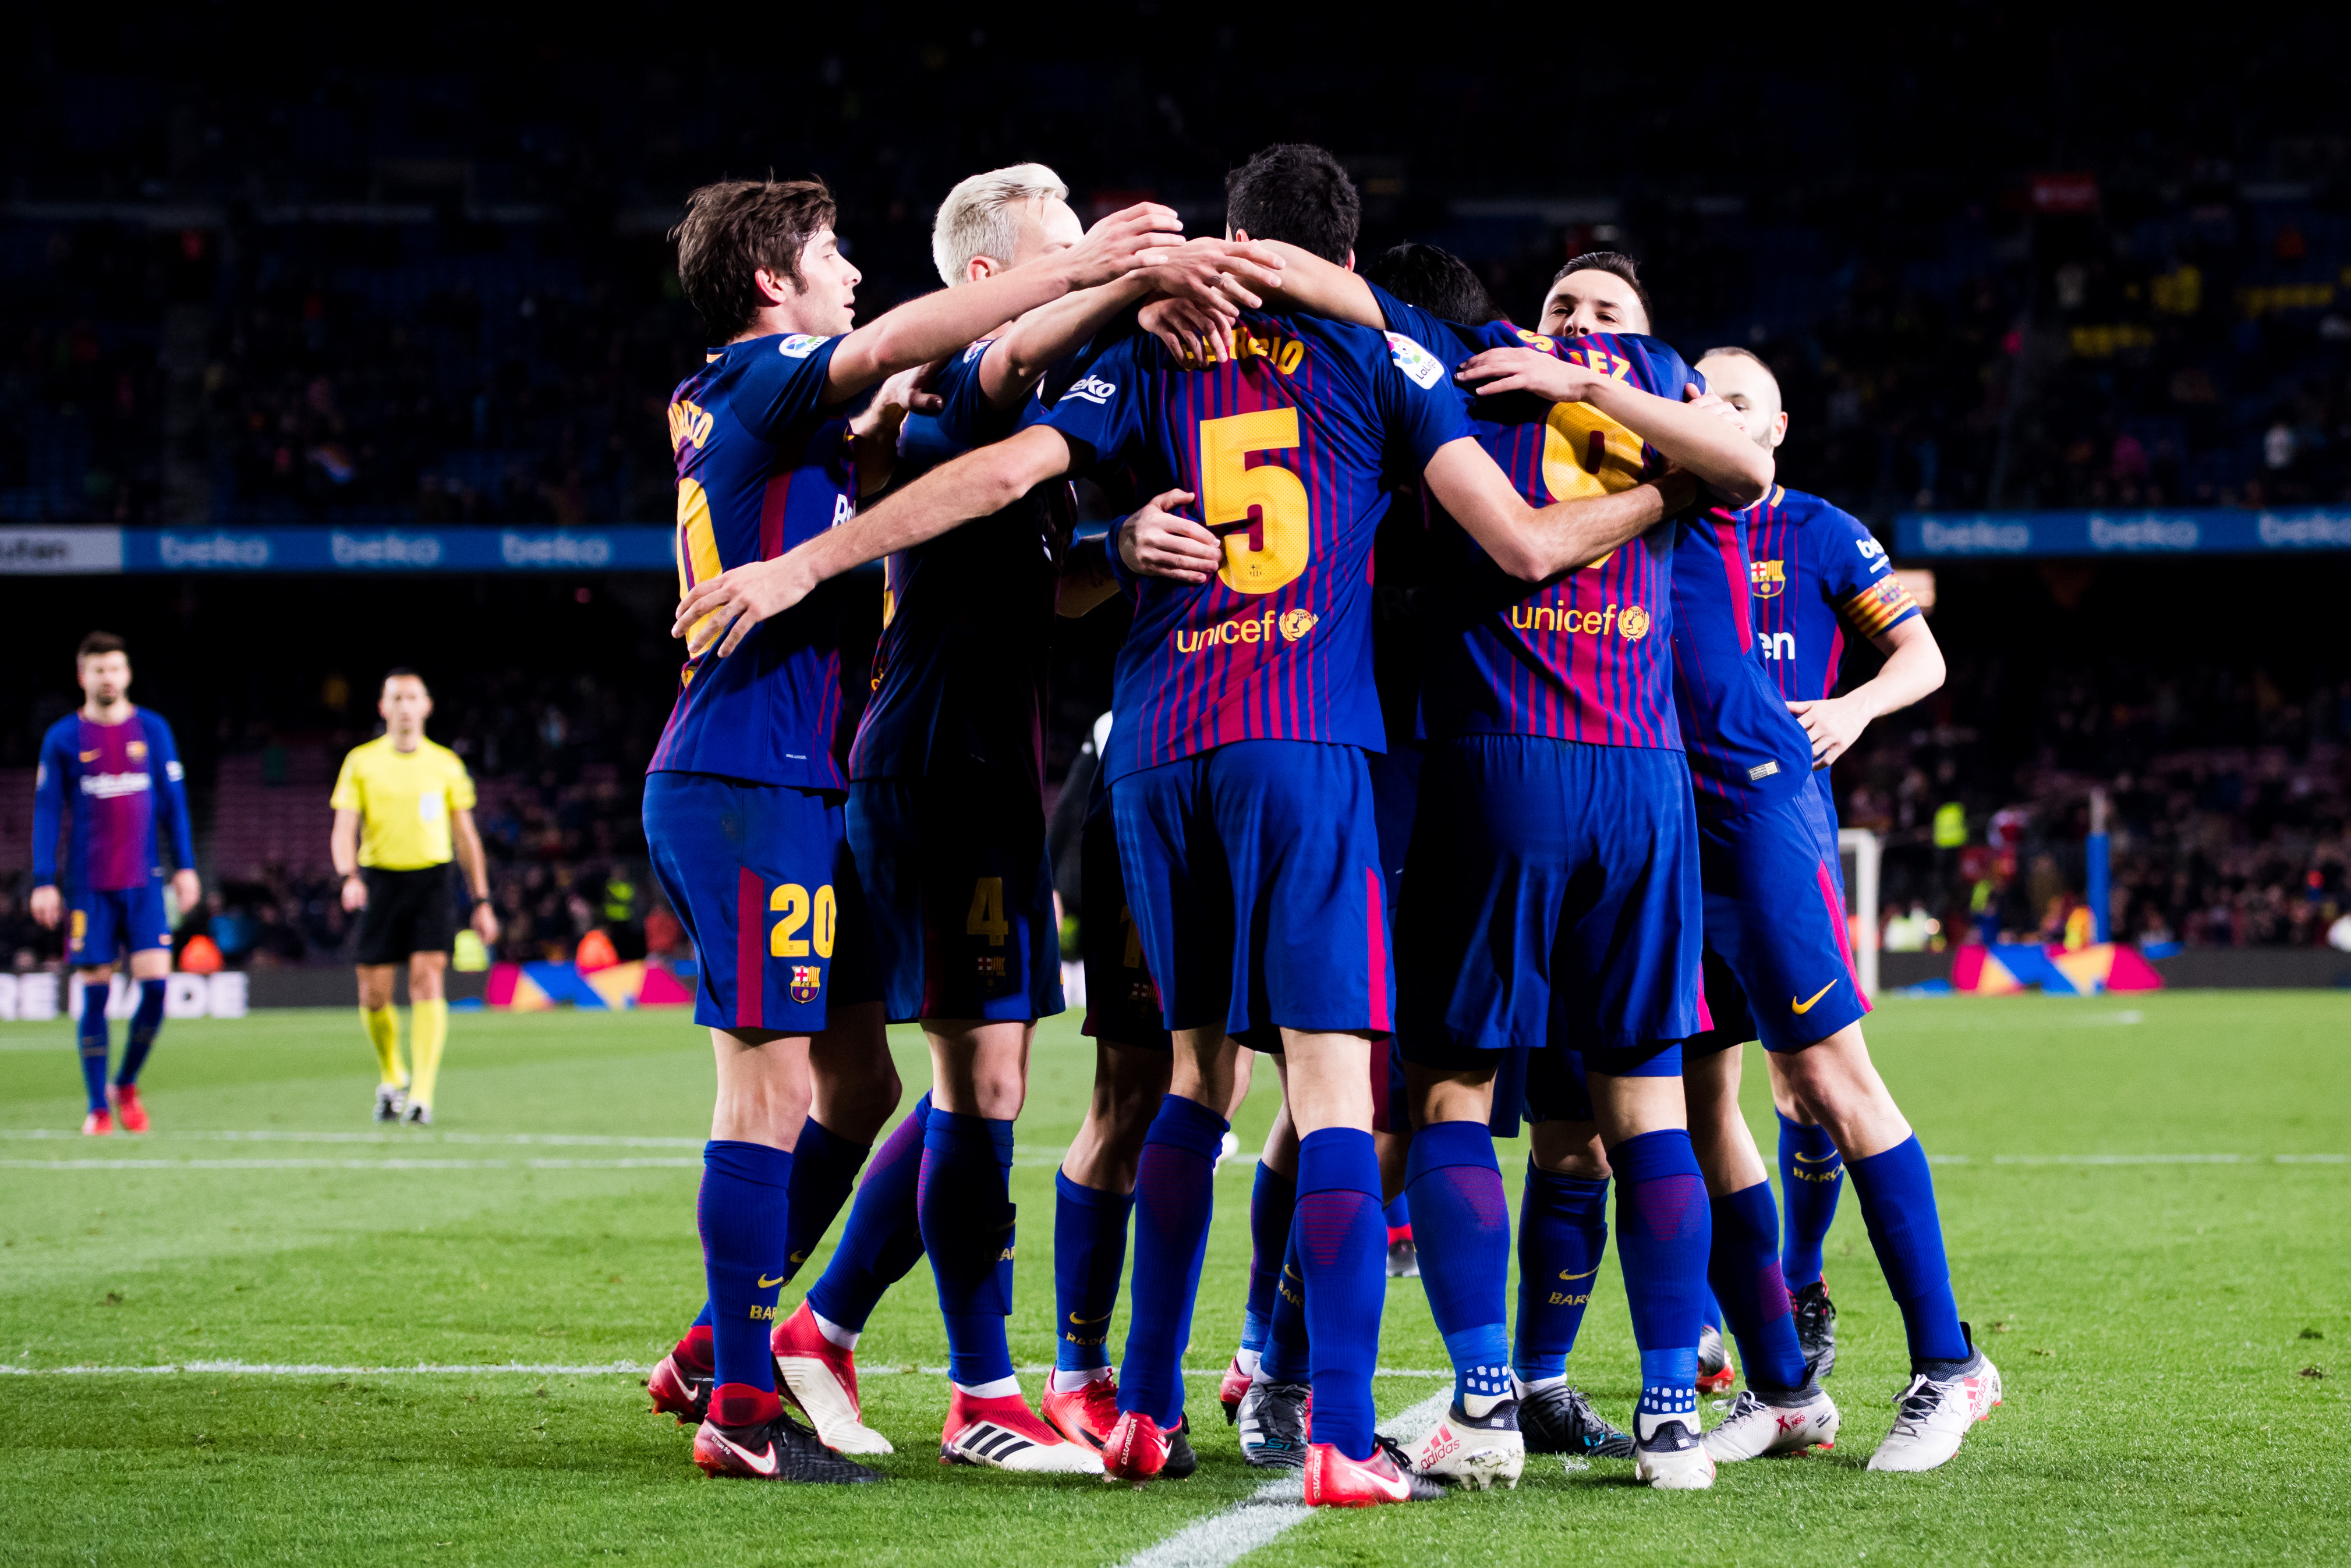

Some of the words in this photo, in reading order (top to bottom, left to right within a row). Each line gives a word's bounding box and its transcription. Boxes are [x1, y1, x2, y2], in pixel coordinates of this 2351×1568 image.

[1415, 358, 1436, 380] LaLiga
[1199, 406, 1310, 595] 5
[1177, 611, 1275, 653] unicef
[1512, 600, 1617, 636] unicef
[769, 883, 837, 959] 20
[966, 877, 1008, 946] 4
[1970, 1375, 1988, 1424] adidas
[1421, 1439, 1460, 1470] adidas
